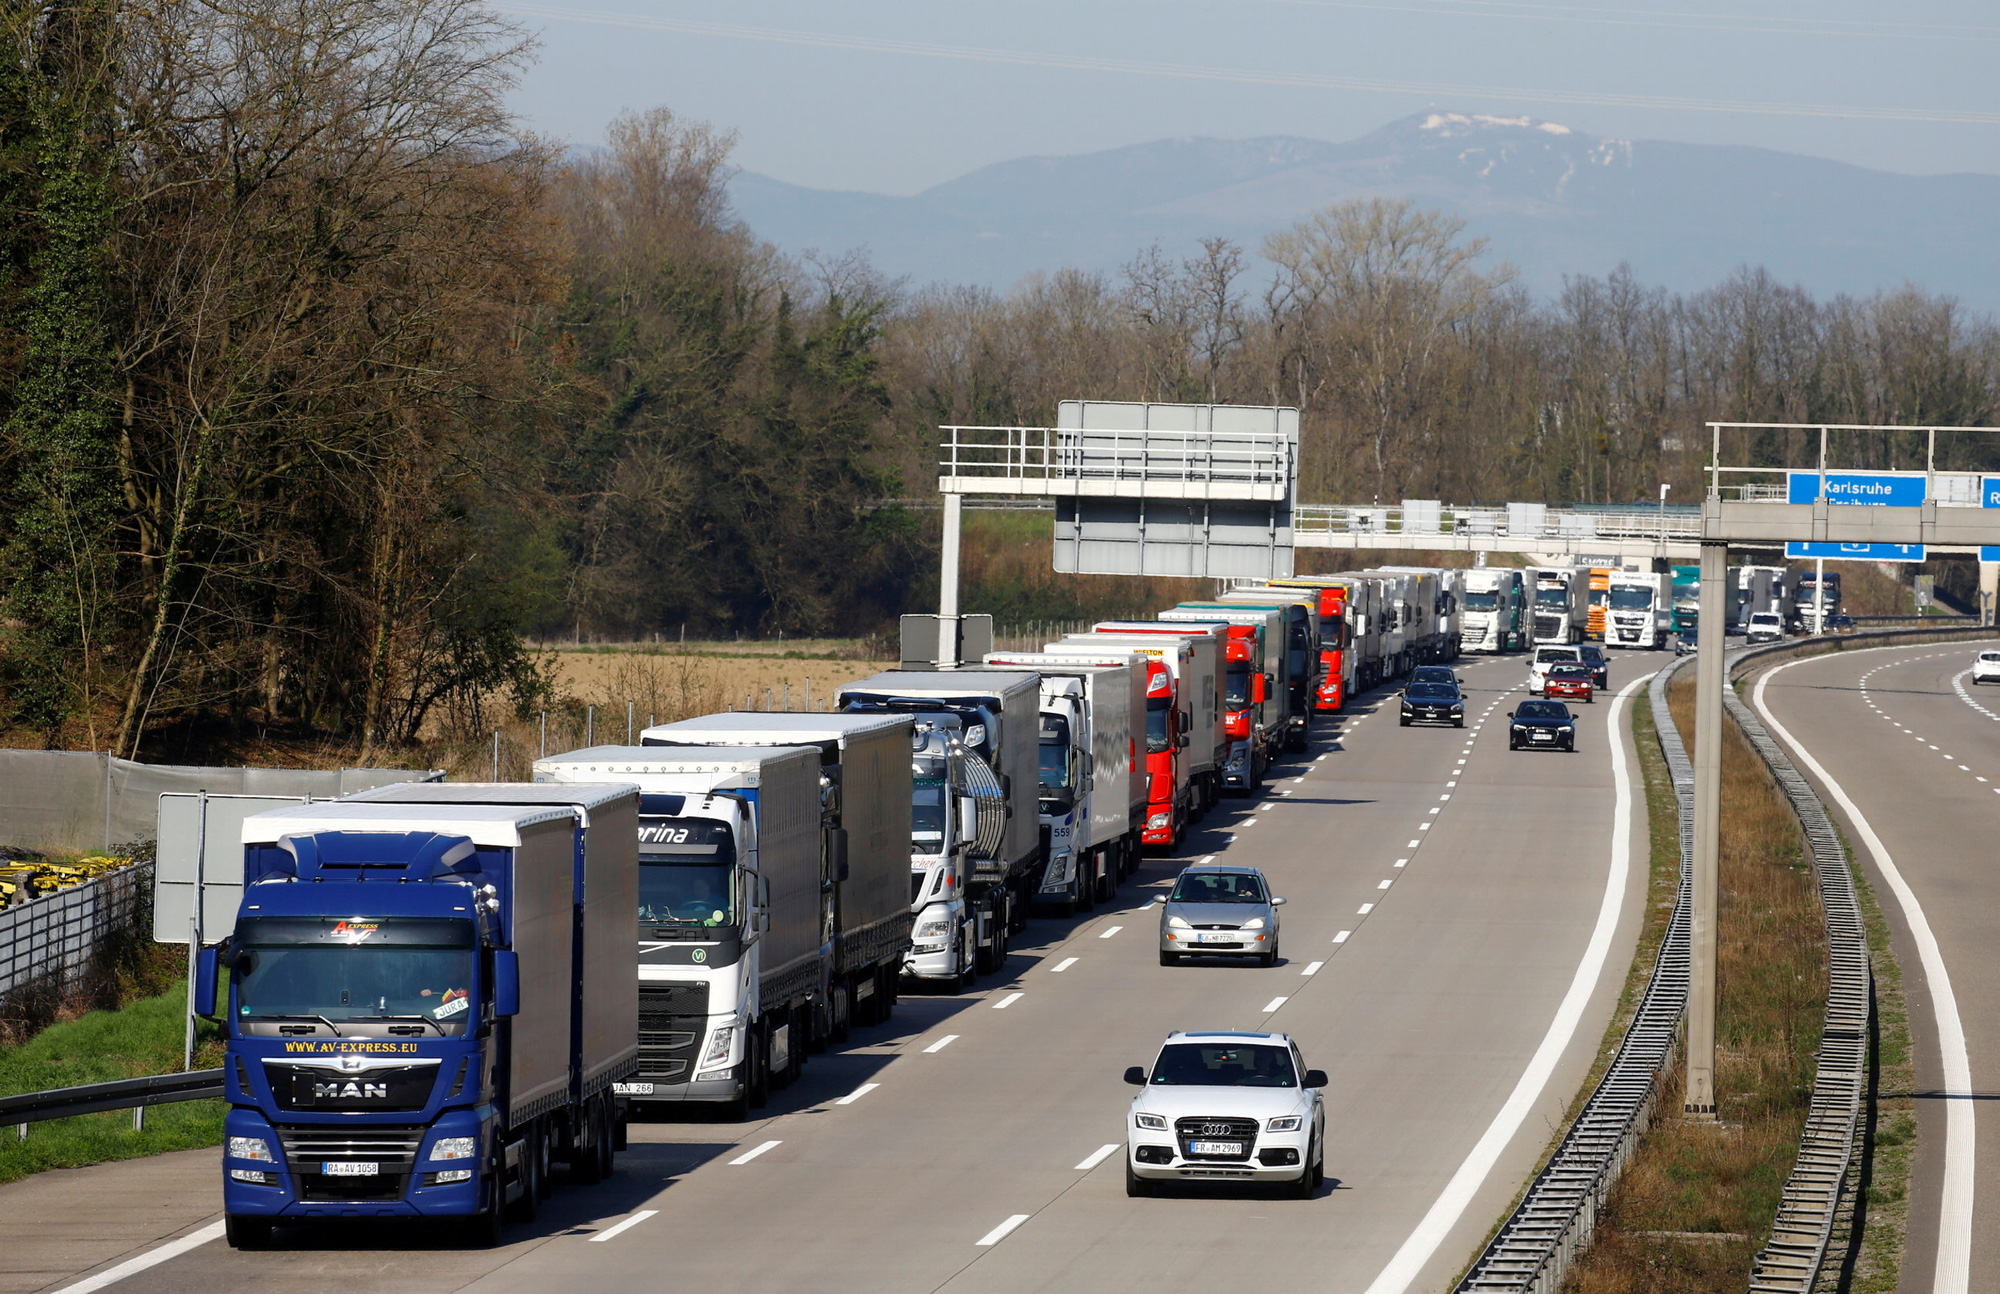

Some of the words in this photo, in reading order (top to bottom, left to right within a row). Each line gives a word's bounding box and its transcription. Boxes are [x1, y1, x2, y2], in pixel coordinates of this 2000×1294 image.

[1824, 481, 1892, 494] Karlsruhe
[1054, 828, 1070, 837] 559
[911, 858, 937, 869] chen
[440, 1000, 464, 1017] JURA
[285, 1041, 418, 1053] WWW.AV-EXPRESS.EU
[315, 1082, 387, 1098] MAN
[636, 1084, 652, 1092] 266
[1195, 1144, 1205, 1152] FR
[1211, 1144, 1220, 1152] AM
[1222, 1144, 1241, 1152] 2969
[328, 1164, 339, 1172] RA
[344, 1164, 355, 1172] AV
[357, 1164, 377, 1172] 1058
